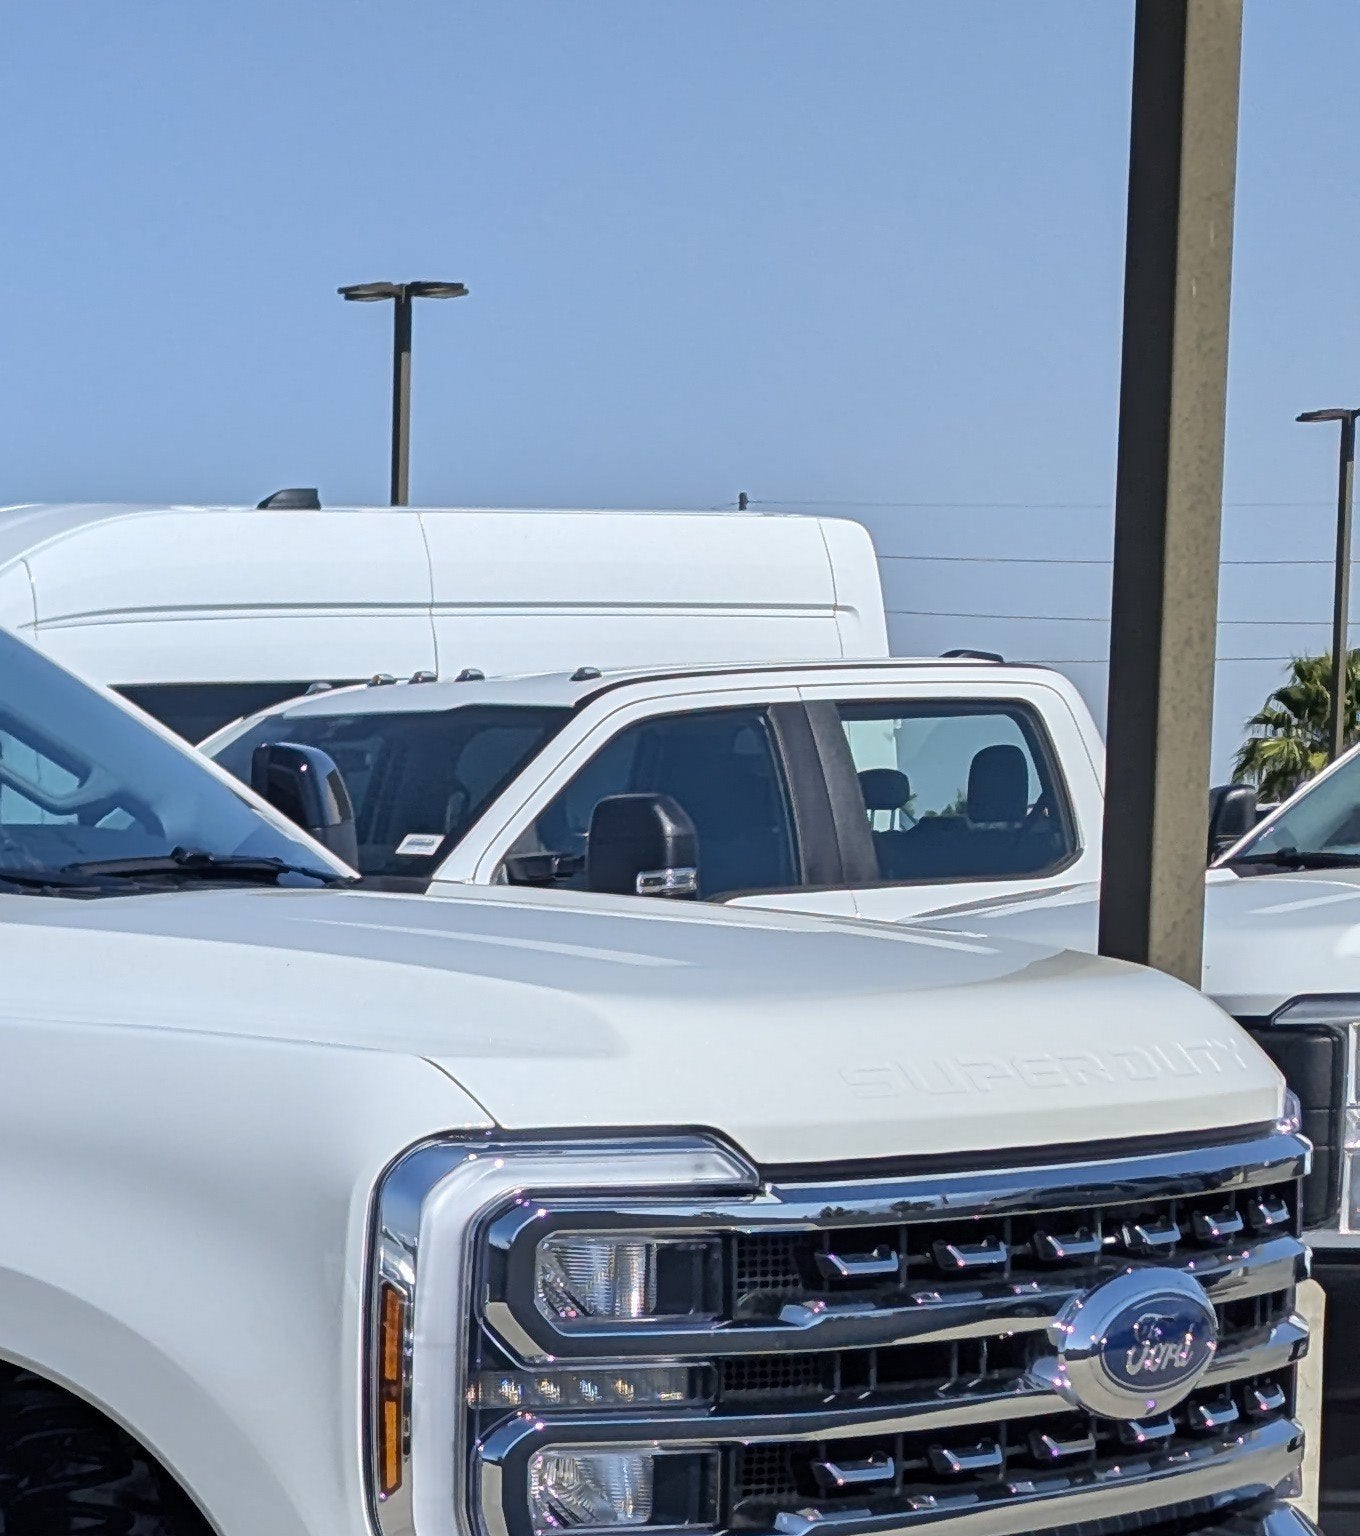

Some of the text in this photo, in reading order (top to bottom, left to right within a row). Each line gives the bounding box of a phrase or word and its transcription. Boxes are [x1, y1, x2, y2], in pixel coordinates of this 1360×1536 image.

[838, 1038, 1248, 1099] SUPER DUTY
[1125, 1312, 1195, 1376] Ford
